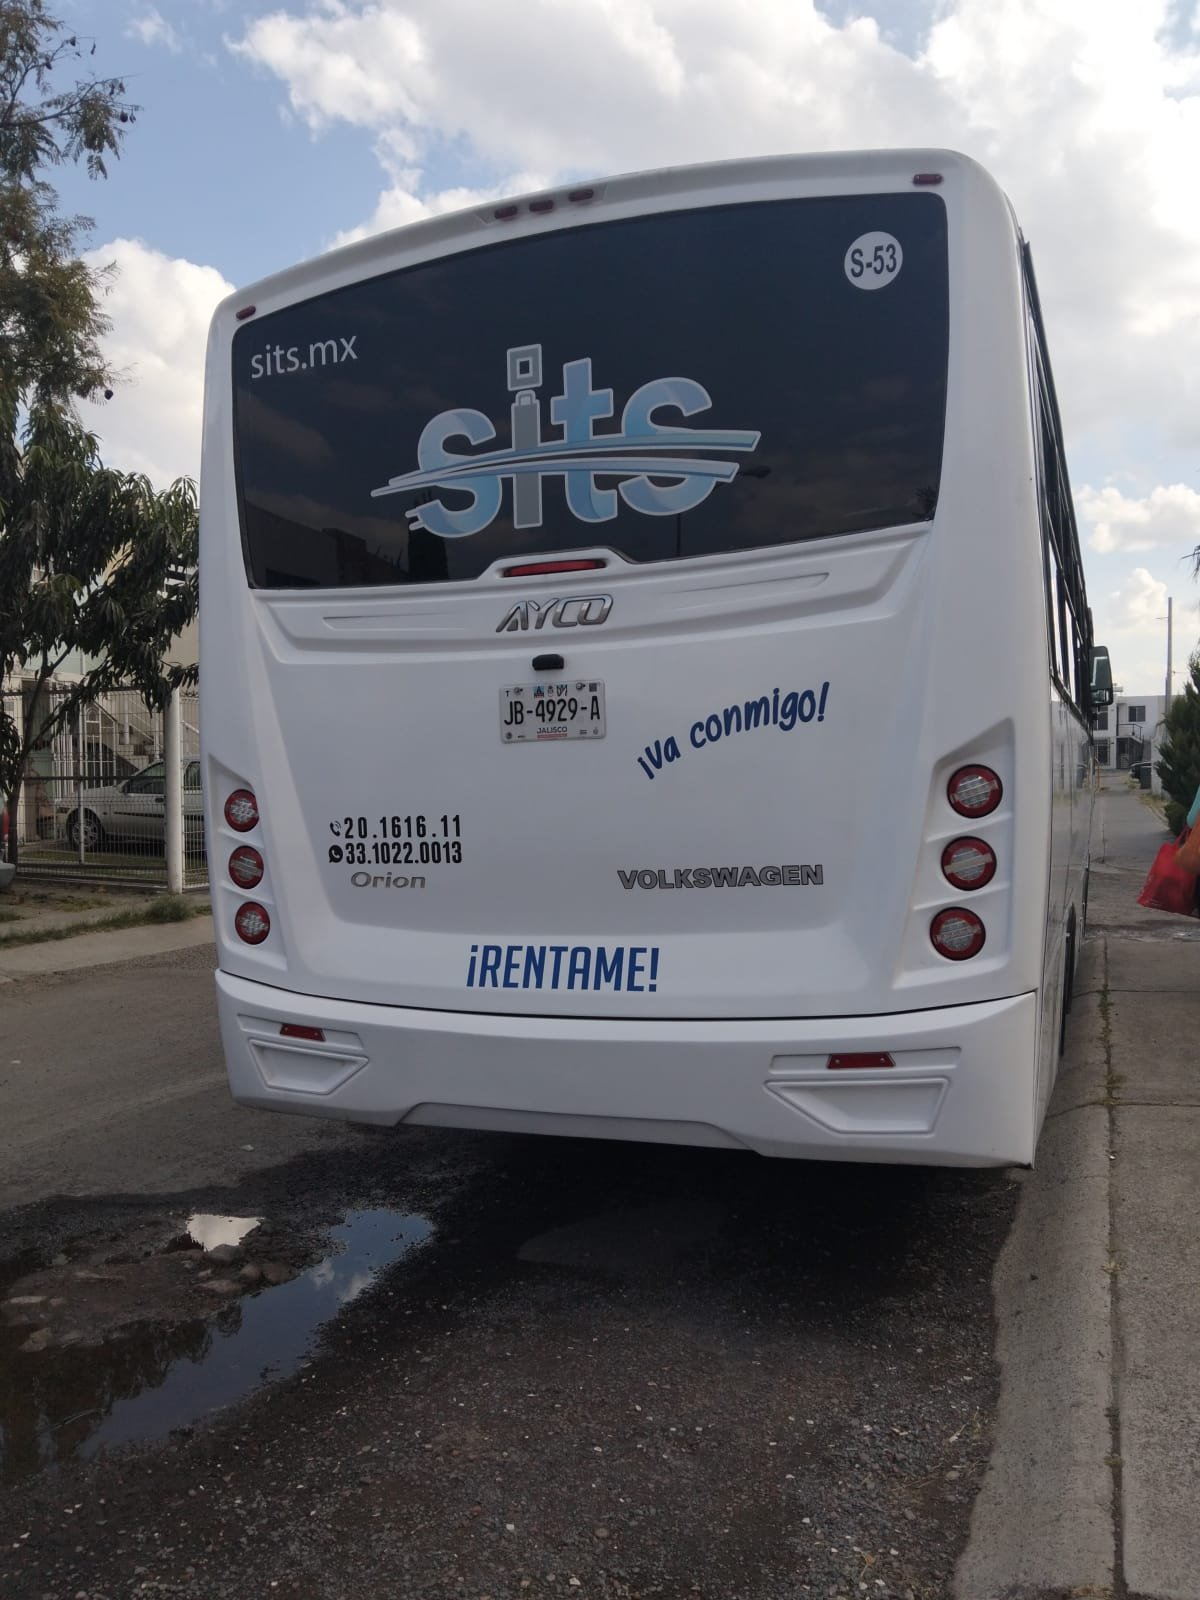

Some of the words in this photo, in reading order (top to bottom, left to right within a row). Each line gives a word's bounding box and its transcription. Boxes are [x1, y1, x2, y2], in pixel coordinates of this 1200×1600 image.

[850, 243, 897, 278] S-53
[251, 335, 358, 379] sits.mx
[404, 343, 716, 540] sits
[495, 593, 614, 633] AYCO
[504, 696, 600, 725] JB-4929-A
[537, 726, 568, 734] JALISCO
[637, 736, 681, 780] ¡Va
[690, 681, 830, 749] conmigo!
[345, 841, 463, 865] 33.1022.0013
[350, 871, 426, 888] Orion
[617, 864, 824, 889] VOLKSWAGEN
[466, 944, 660, 993] ¡RENTAME!
